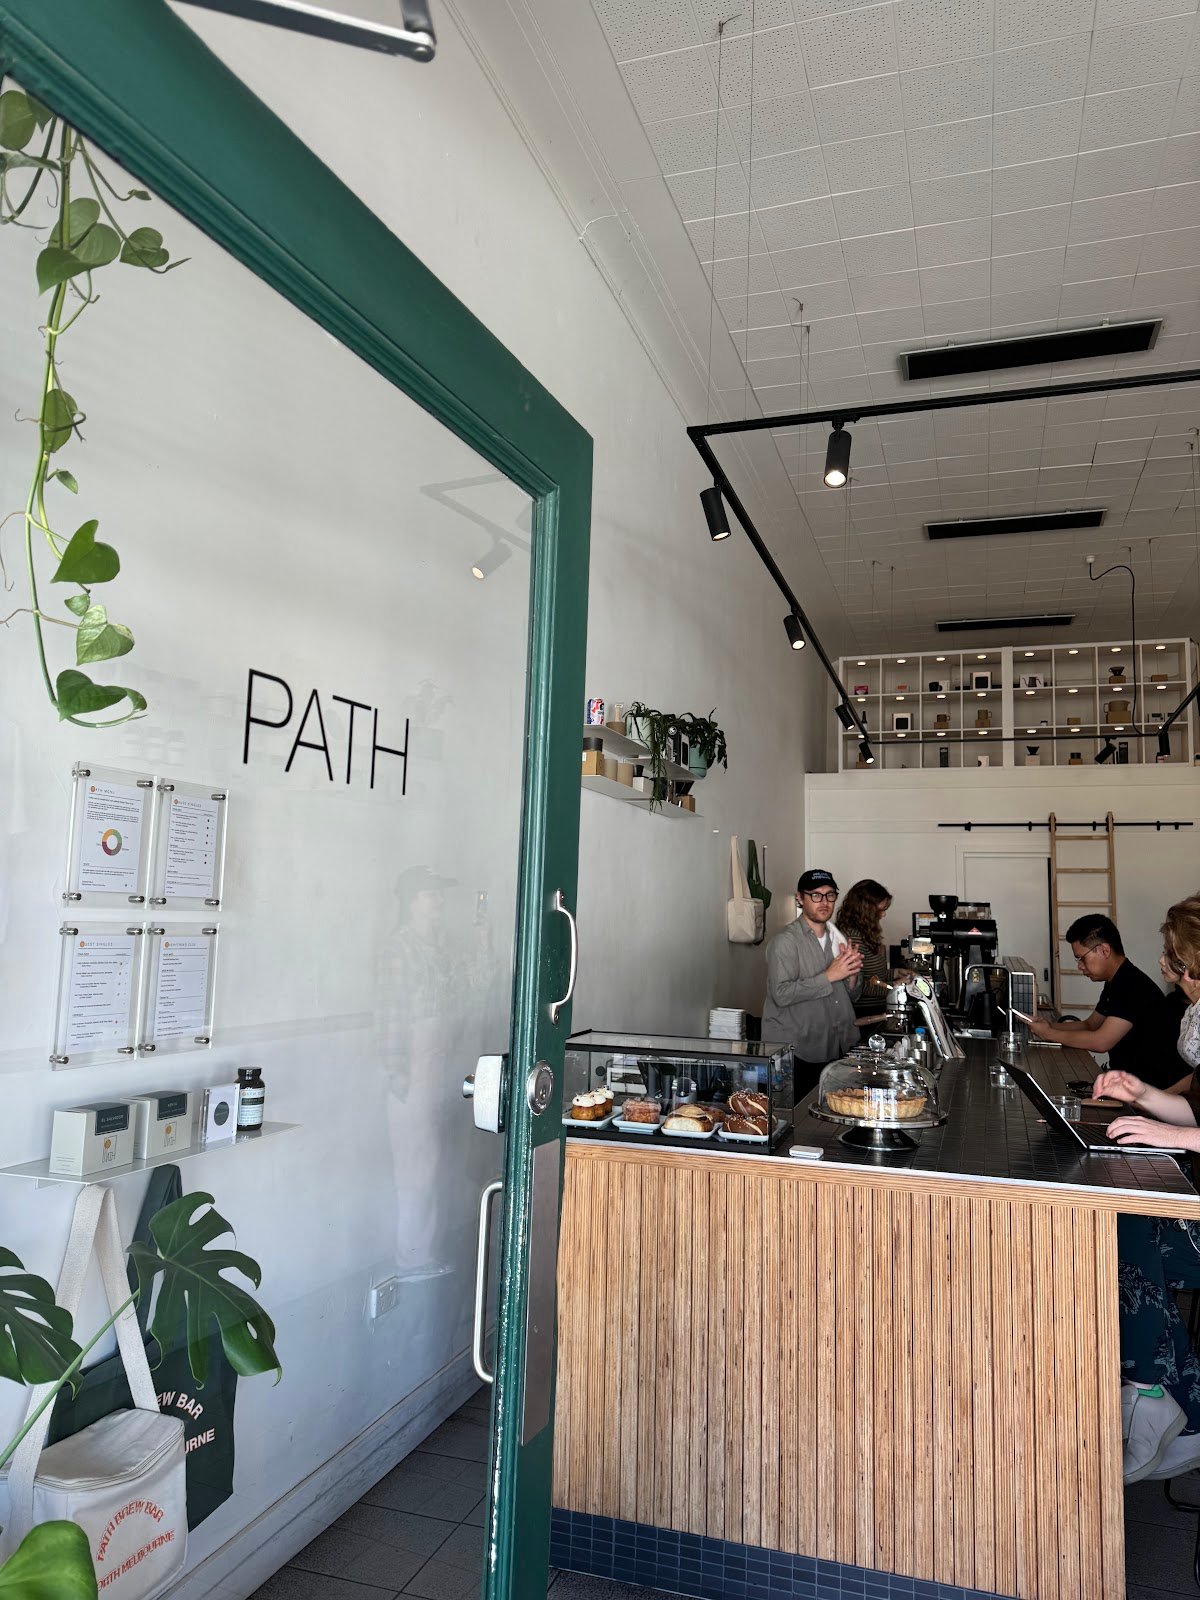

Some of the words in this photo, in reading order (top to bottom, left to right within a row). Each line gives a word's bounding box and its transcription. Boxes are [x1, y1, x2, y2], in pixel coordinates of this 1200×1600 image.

[243, 668, 409, 796] PATH
[176, 1393, 204, 1420] BAR
[97, 1520, 116, 1561] PATH
[114, 1499, 145, 1526] BREW
[145, 1500, 164, 1523] BAR
[121, 1529, 175, 1578] MELBOURNE
